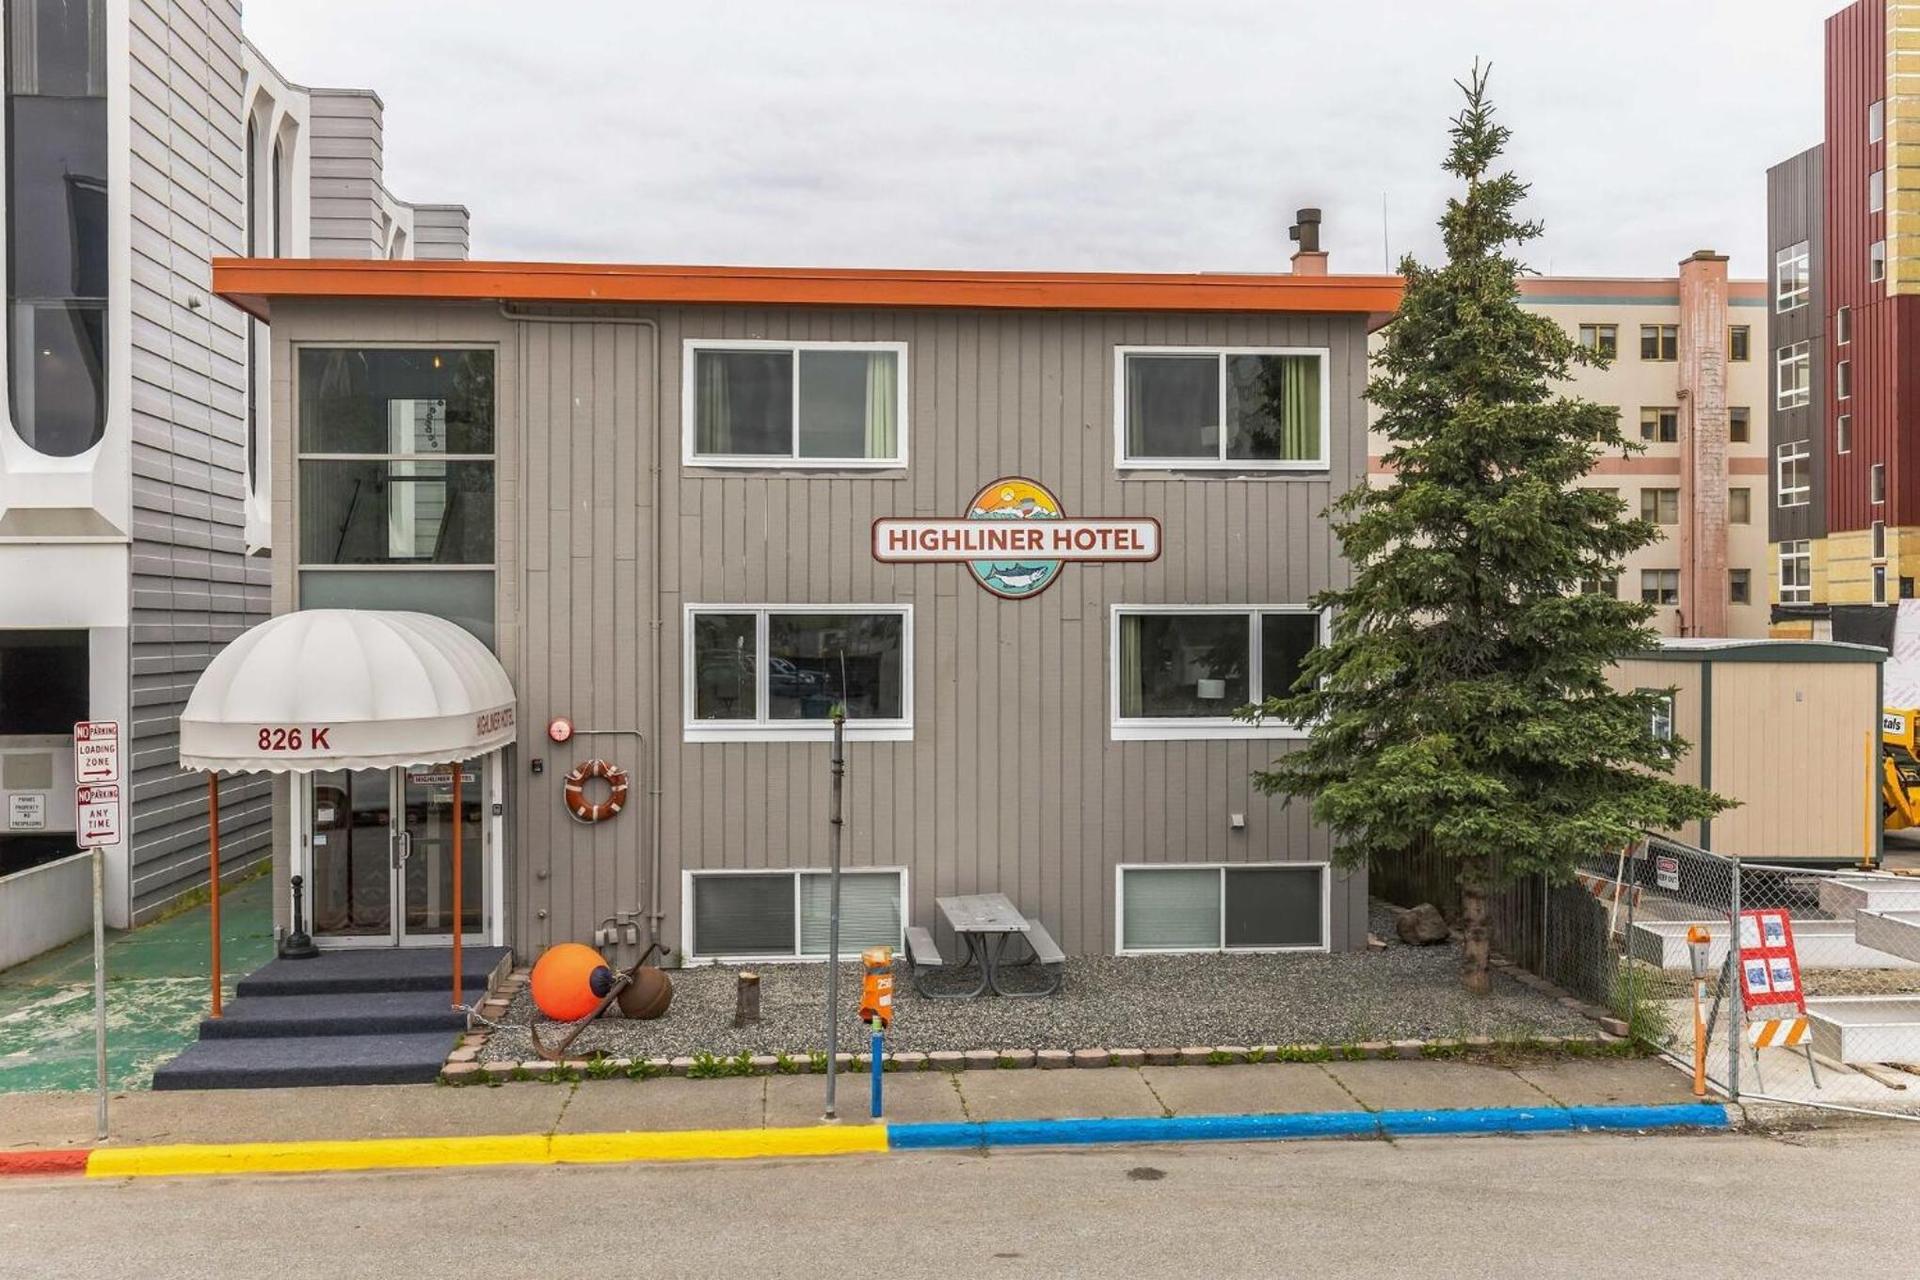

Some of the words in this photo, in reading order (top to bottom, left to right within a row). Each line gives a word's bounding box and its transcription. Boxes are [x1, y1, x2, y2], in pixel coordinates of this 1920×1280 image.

[888, 528, 1044, 551] HIGHLINER
[1052, 528, 1145, 551] HOTEL
[78, 726, 90, 739] NO
[90, 725, 118, 737] PARKING
[258, 727, 303, 751] 826
[311, 727, 331, 750] K
[79, 744, 116, 755] LOADING
[85, 757, 110, 767] ZONE
[79, 789, 91, 802] NO
[90, 788, 119, 800] PARKING
[89, 808, 109, 818] ANY
[88, 819, 111, 829] TIME
